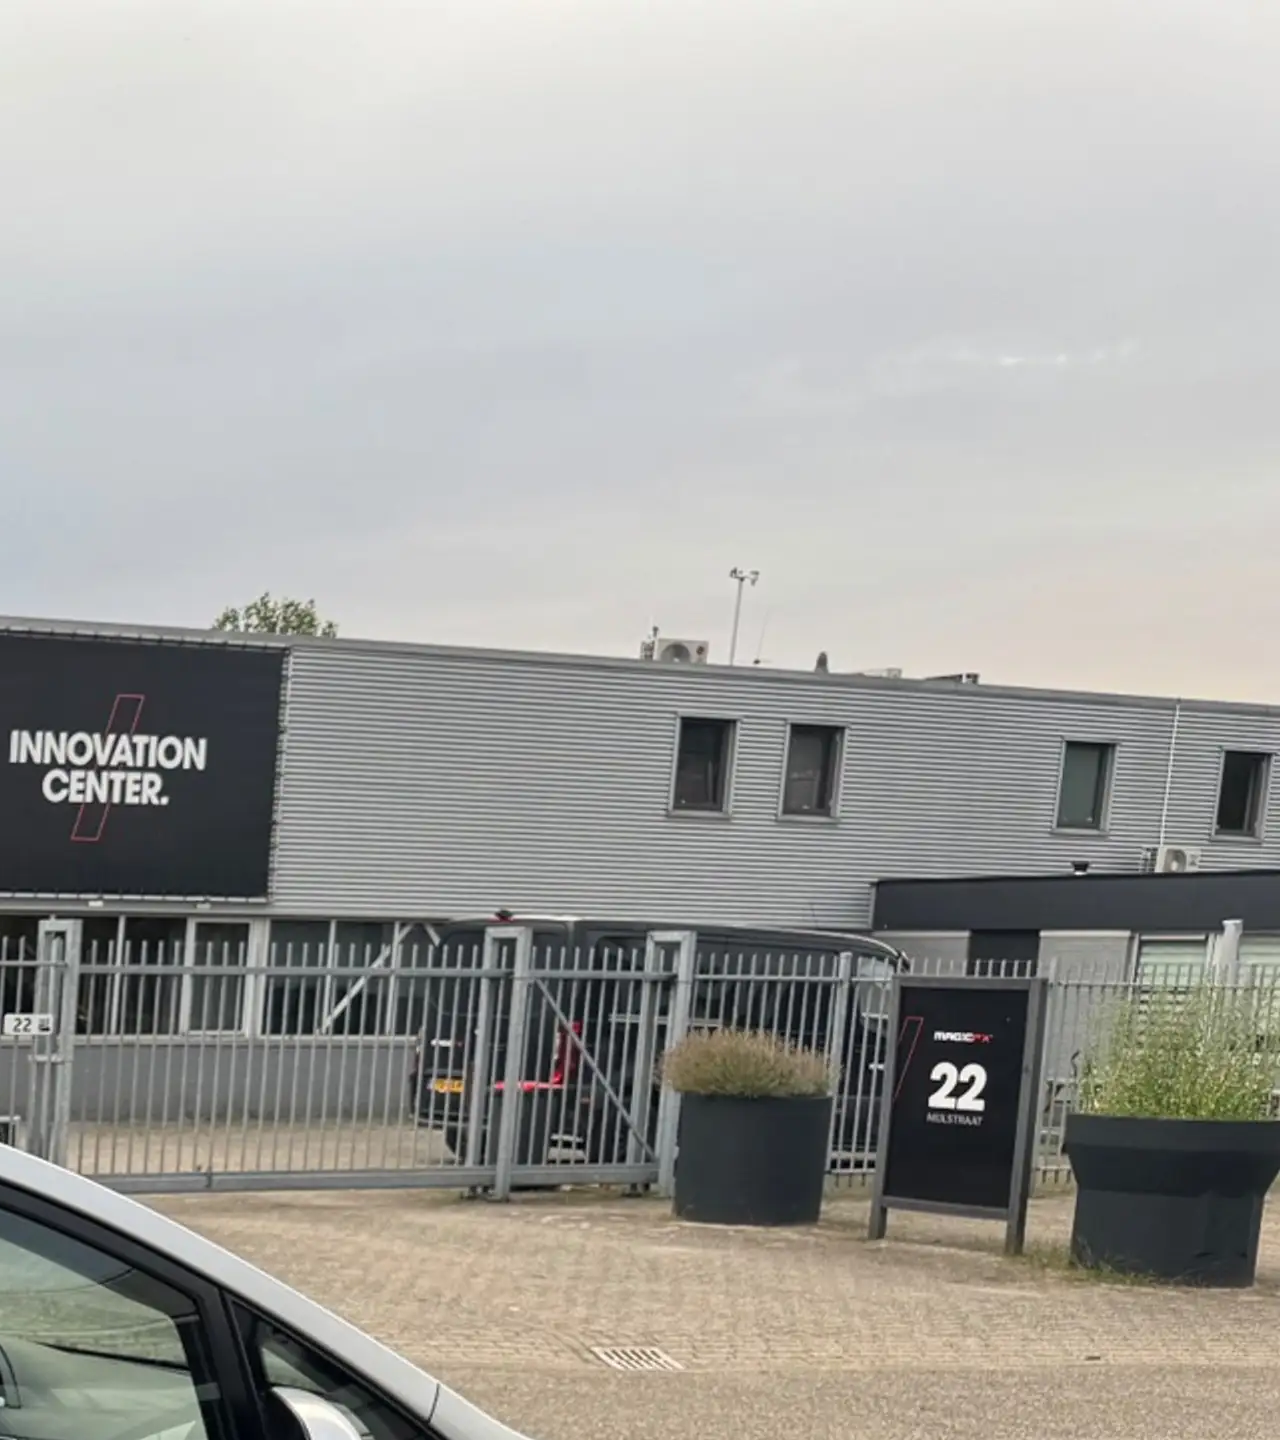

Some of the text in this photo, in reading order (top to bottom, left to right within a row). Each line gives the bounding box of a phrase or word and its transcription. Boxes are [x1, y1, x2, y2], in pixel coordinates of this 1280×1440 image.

[9, 730, 207, 770] INNOVATION
[42, 768, 169, 805] CENTER.
[13, 1017, 32, 1032] 22
[928, 1061, 987, 1111] 22
